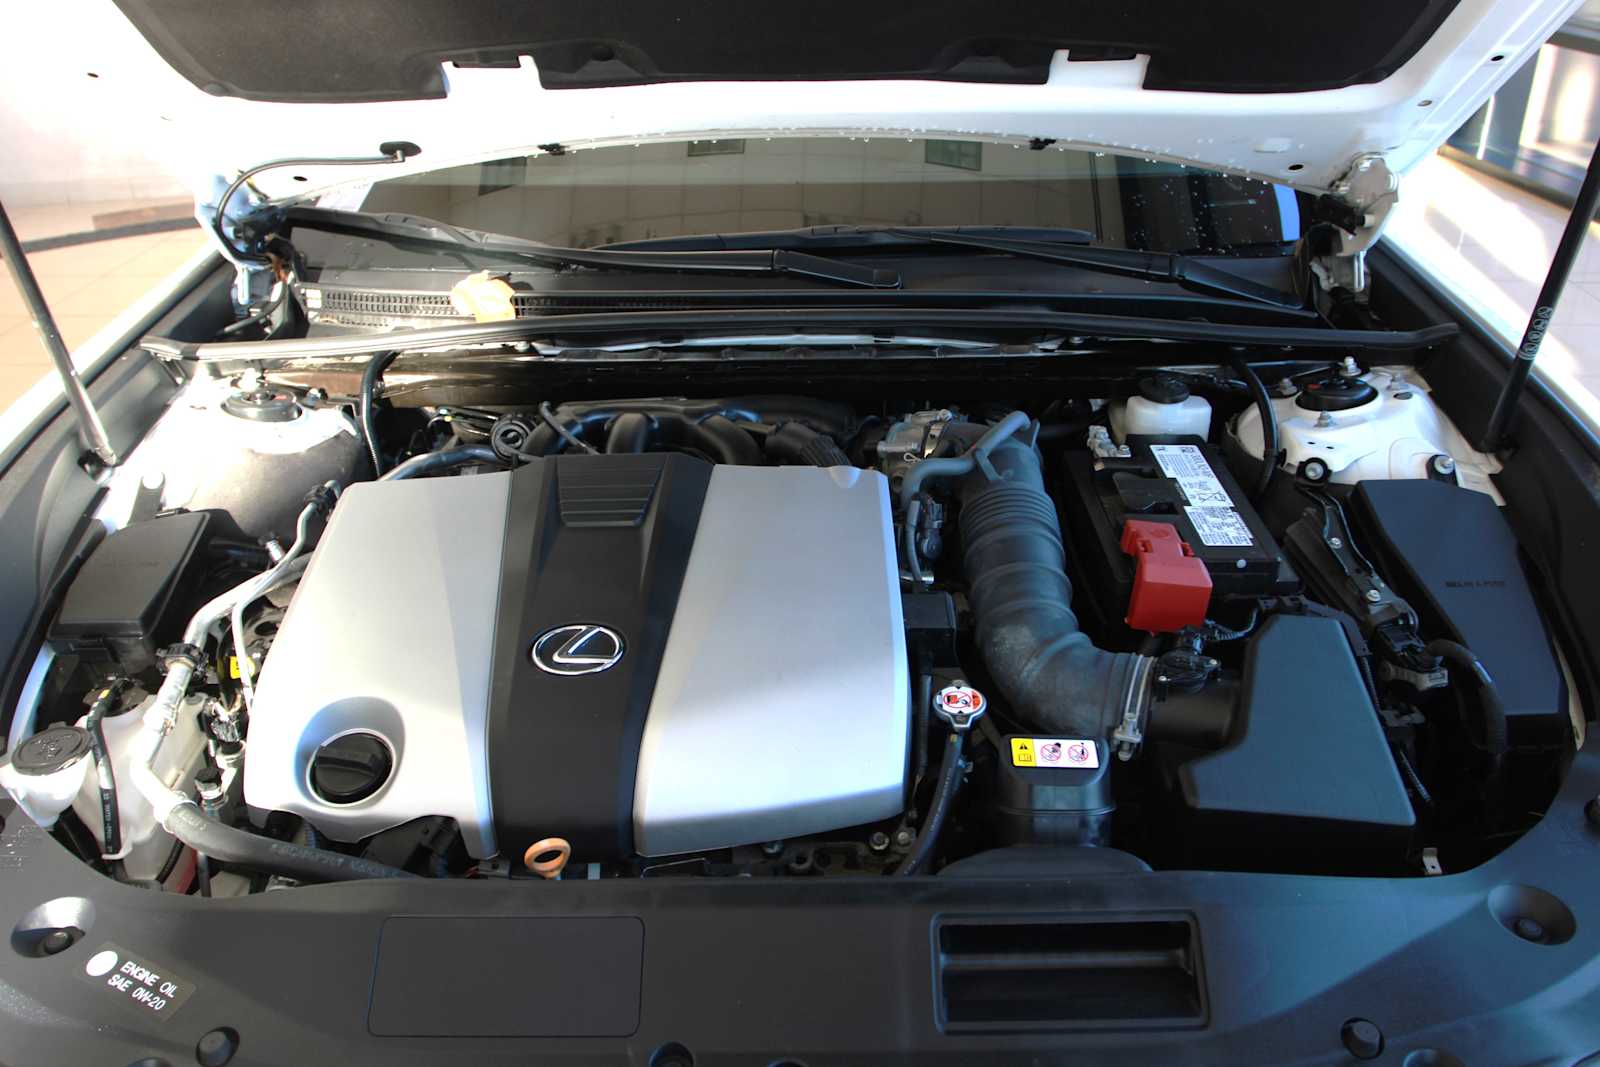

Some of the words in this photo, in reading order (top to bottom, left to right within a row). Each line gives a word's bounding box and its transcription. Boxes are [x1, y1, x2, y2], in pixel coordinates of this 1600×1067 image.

[107, 974, 133, 992] SAE
[131, 986, 167, 1010] 0W-20
[120, 961, 160, 986] ENGINE
[159, 982, 178, 998] OIL
